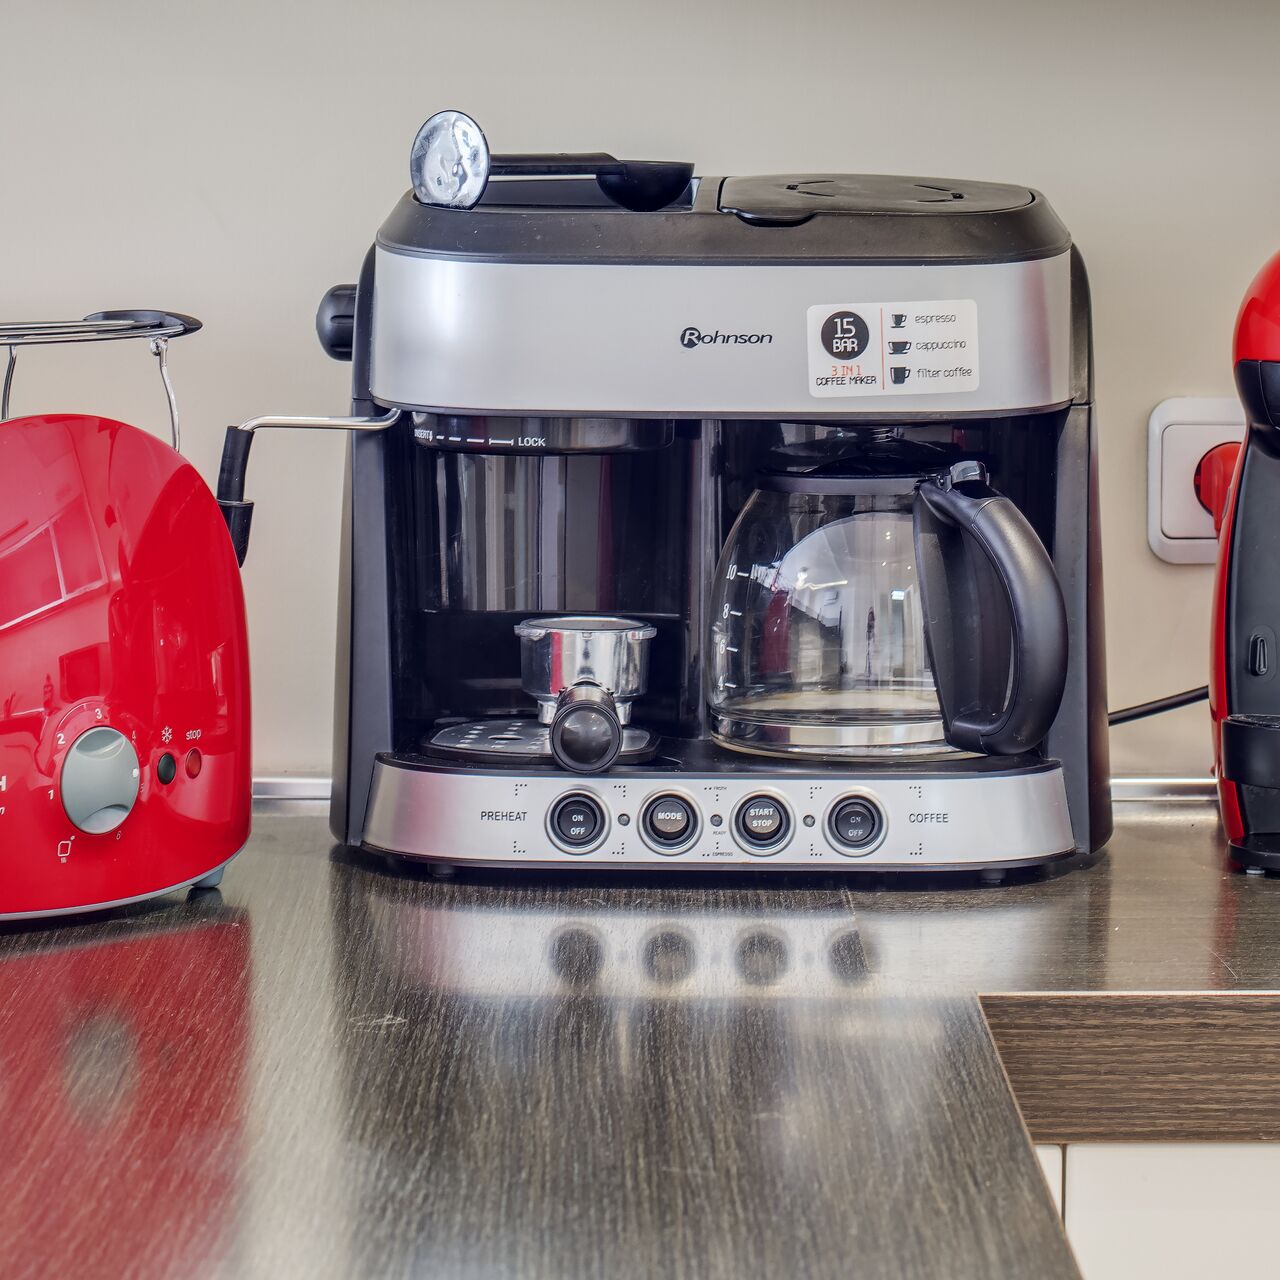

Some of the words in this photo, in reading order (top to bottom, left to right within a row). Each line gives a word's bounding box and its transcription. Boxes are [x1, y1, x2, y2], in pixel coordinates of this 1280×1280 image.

[915, 314, 956, 326] espresso
[833, 317, 856, 338] 15
[680, 327, 773, 349] Rohnson
[832, 338, 858, 353] BAR
[915, 339, 967, 352] cappuccino
[831, 365, 837, 377] 3
[841, 365, 853, 376] IN
[856, 365, 862, 375] 1
[916, 368, 940, 379] filter
[943, 367, 972, 378] coffee
[815, 376, 846, 386] COFFEE
[849, 376, 877, 385] MAKER
[518, 437, 546, 447] LOCK
[726, 564, 737, 580] 10
[723, 603, 729, 619] 8
[95, 708, 102, 719] 3
[57, 733, 65, 744] 2
[185, 729, 201, 740] stop
[48, 789, 54, 800] 1
[480, 811, 527, 822] PREHEAT
[657, 812, 682, 820] MODE
[749, 808, 773, 816] START
[909, 813, 949, 823] COFFEE
[570, 827, 585, 835] OFF
[848, 829, 863, 837] OFF
